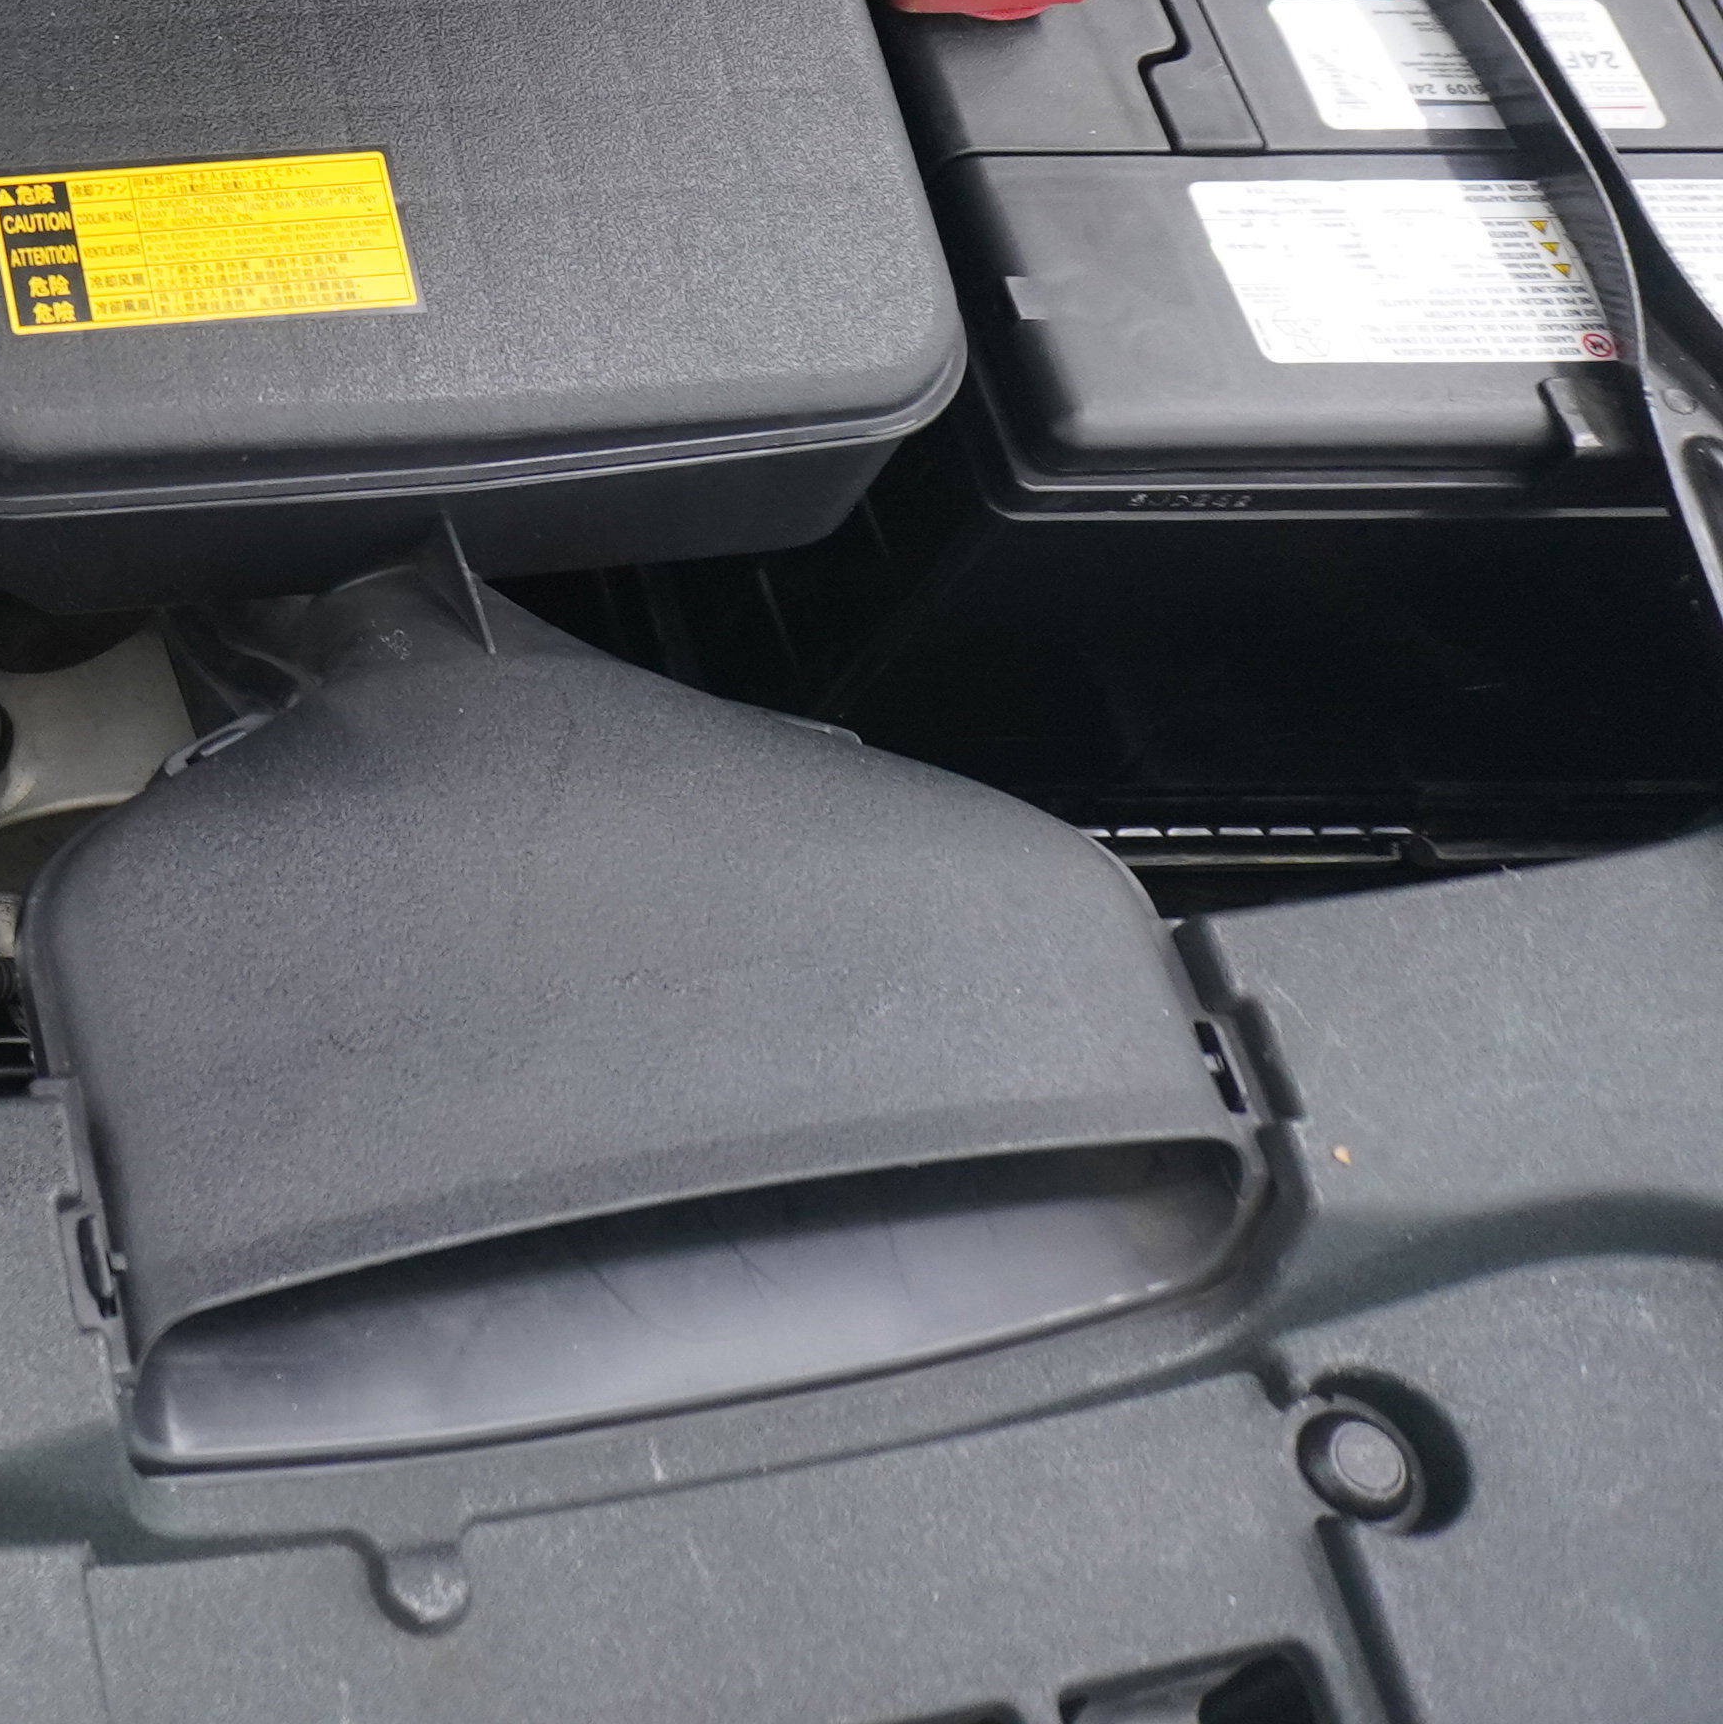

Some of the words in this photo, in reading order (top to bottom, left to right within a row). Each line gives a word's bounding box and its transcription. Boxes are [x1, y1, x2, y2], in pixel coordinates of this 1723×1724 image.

[0, 210, 73, 234] CAUTION
[75, 211, 111, 226] COOLING
[112, 210, 134, 223] FANS
[7, 243, 79, 268] ATTENTION
[82, 243, 141, 258] VENTILATEURS
